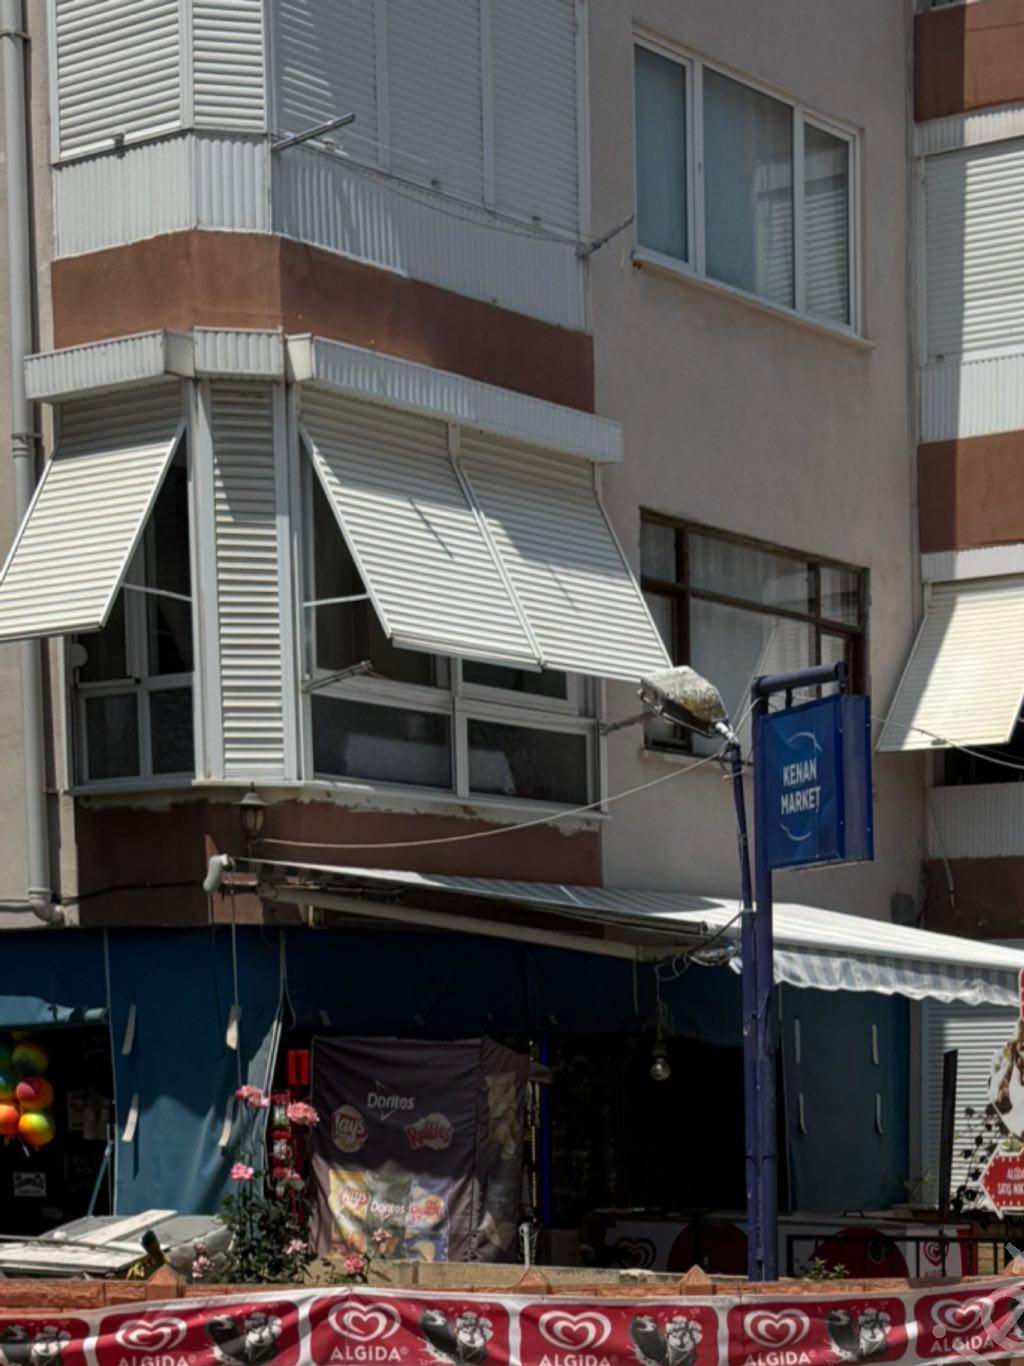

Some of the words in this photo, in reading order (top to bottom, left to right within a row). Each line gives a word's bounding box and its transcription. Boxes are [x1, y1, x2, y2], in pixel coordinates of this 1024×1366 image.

[783, 758, 817, 787] KENAN
[781, 786, 822, 815] MARKET
[367, 1092, 415, 1110] Doritos
[371, 1200, 405, 1215] Doritos
